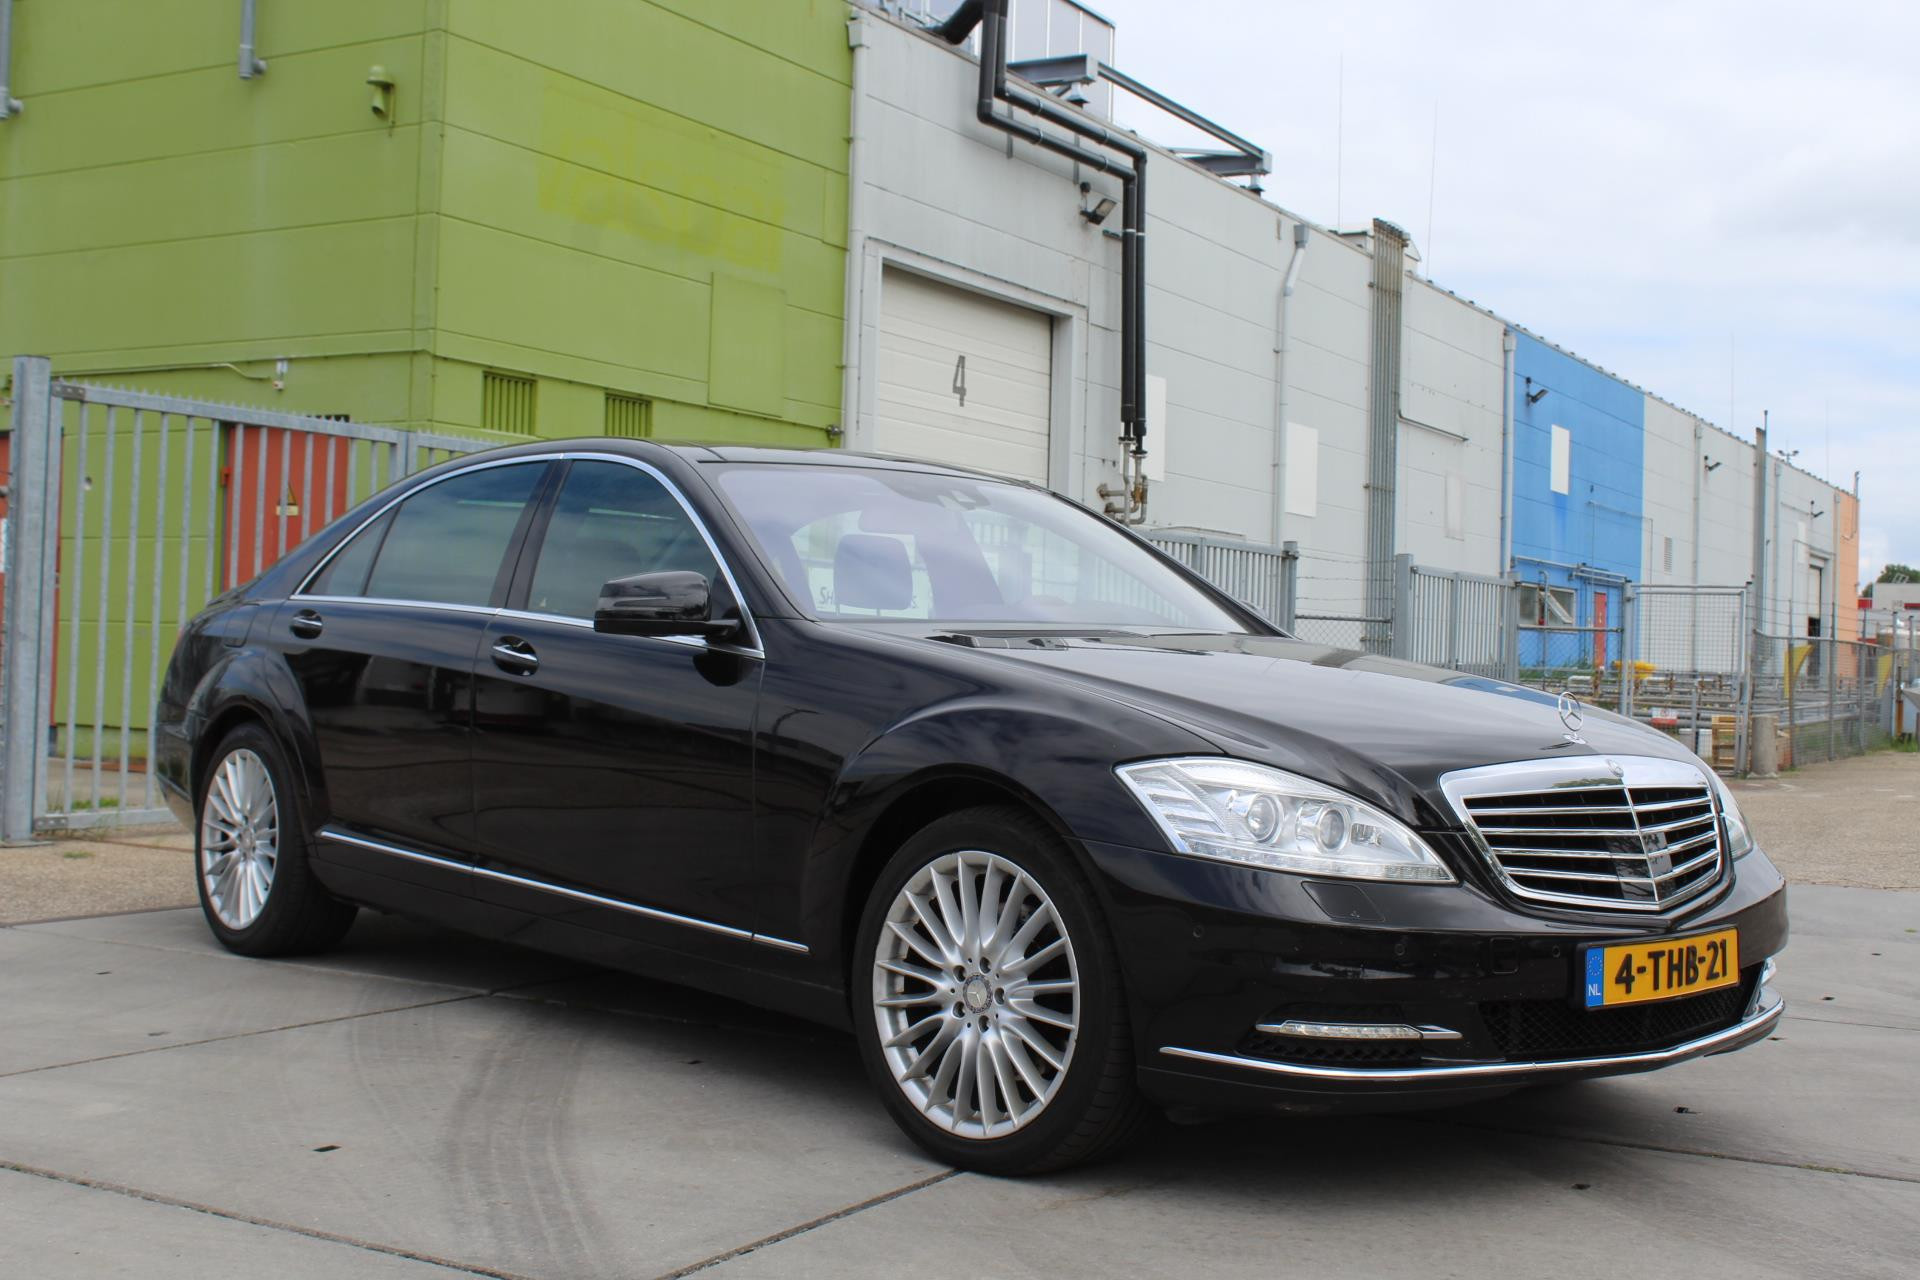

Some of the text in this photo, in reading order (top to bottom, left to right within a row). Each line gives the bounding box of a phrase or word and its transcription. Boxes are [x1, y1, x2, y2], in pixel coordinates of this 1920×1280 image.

[952, 355, 967, 407] 4
[1588, 984, 1601, 997] NL
[1614, 939, 1728, 995] 4-THB-21
